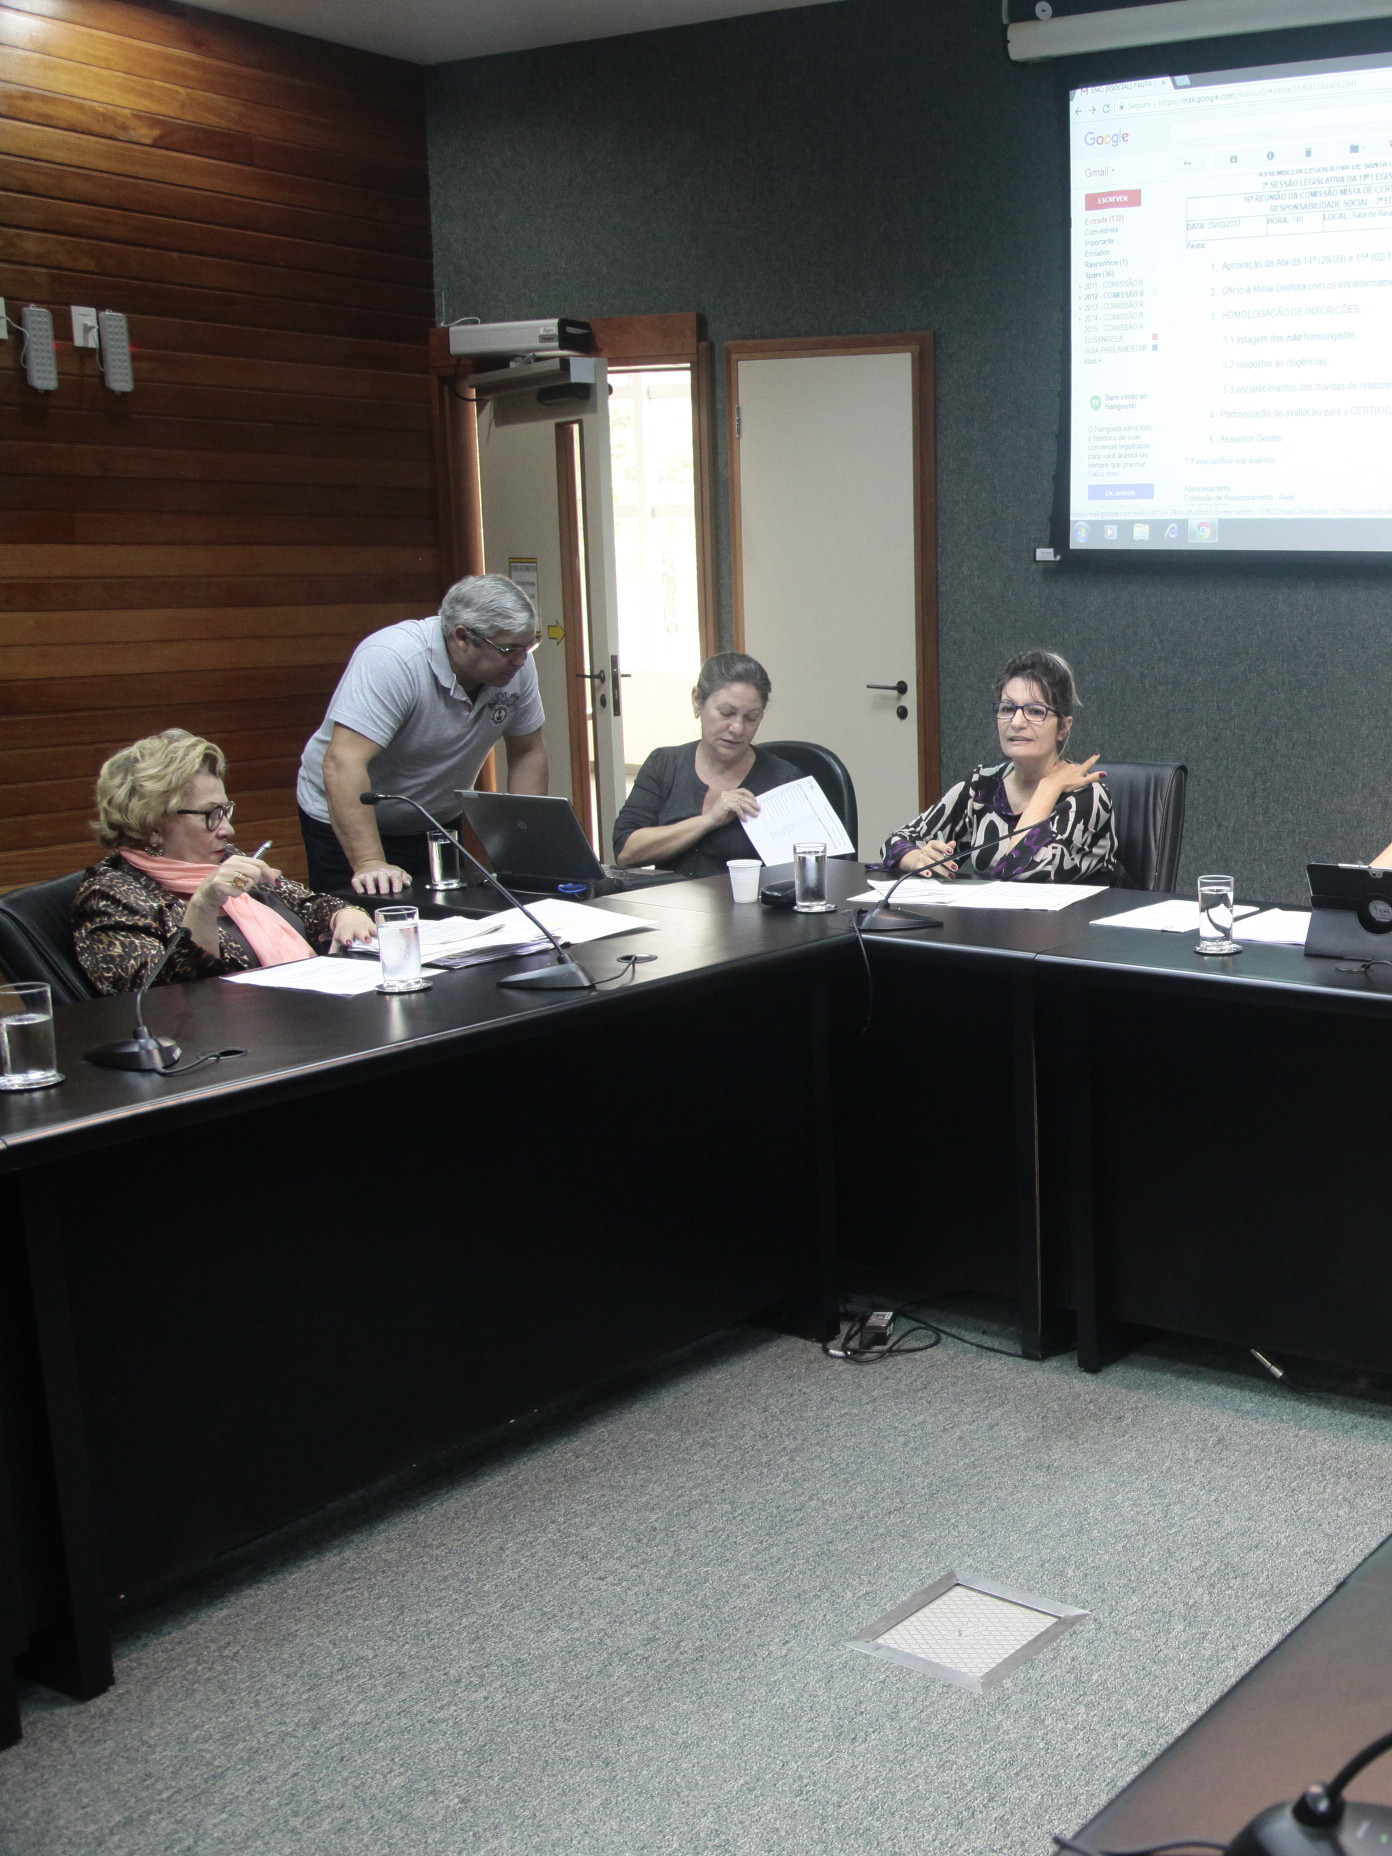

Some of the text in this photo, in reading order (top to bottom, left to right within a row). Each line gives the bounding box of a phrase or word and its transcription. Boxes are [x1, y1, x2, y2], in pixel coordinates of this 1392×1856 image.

[1128, 102, 1150, 110] Seguro
[1084, 129, 1129, 147] Google
[1085, 167, 1109, 177] Gmail
[1270, 178, 1298, 188] SESSÃO
[1300, 176, 1345, 186] LEGISLATIVA
[1347, 174, 1357, 182] DA
[1255, 192, 1287, 202] REUNIÃO
[1300, 188, 1338, 198] COMISSÃO
[1340, 186, 1361, 196] MISTA
[1098, 196, 1128, 204] ESCREVER
[1270, 200, 1340, 212] RESPONSABILIDADE
[1344, 198, 1370, 207] SOCIAL
[1351, 210, 1367, 218] Sala
[1368, 209, 1376, 217] de
[1085, 217, 1108, 225] Entrada
[1207, 220, 1241, 229] 09/10/2017
[1267, 216, 1290, 224] HORA:
[1085, 238, 1114, 246] Importante
[1085, 258, 1128, 268] Rascunhos (1)
[1222, 260, 1262, 271] Aprovação
[1291, 258, 1301, 266] da
[1318, 255, 1346, 266] (29/09)
[1085, 272, 1101, 280] Spam
[1085, 278, 1137, 290] 2011 COMISSÃO
[1222, 286, 1244, 295] Ofício
[1252, 285, 1273, 293] Mesa
[1275, 283, 1306, 292] Diretora
[1103, 290, 1138, 299] COMISSÃO
[1103, 300, 1138, 310] COMISSÃO
[1103, 311, 1138, 321] COMISSÃO
[1221, 307, 1289, 319] HOMOLOGAÇÃO
[1292, 307, 1303, 316] DE
[1103, 322, 1138, 332] COMISSÃO
[1084, 335, 1123, 344] ELISANGELA
[1236, 335, 1268, 345] listagem
[1270, 334, 1284, 342] das
[1287, 333, 1301, 342] não
[1100, 344, 1147, 353] PARLAMENTAR
[1236, 360, 1273, 369] respostas
[1236, 384, 1297, 393] esclarecimentos
[1299, 383, 1312, 391] das
[1315, 382, 1345, 391] dúvidas
[1347, 382, 1357, 390] de
[1105, 402, 1136, 411] Hangouts!
[1220, 408, 1271, 419] Padronização
[1273, 409, 1283, 417] de
[1286, 408, 1321, 418] avaliação
[1324, 409, 1342, 418] para
[1094, 425, 1122, 433] Hangouts
[1220, 435, 1255, 443] Assuntos
[1210, 457, 1233, 466] justificar
